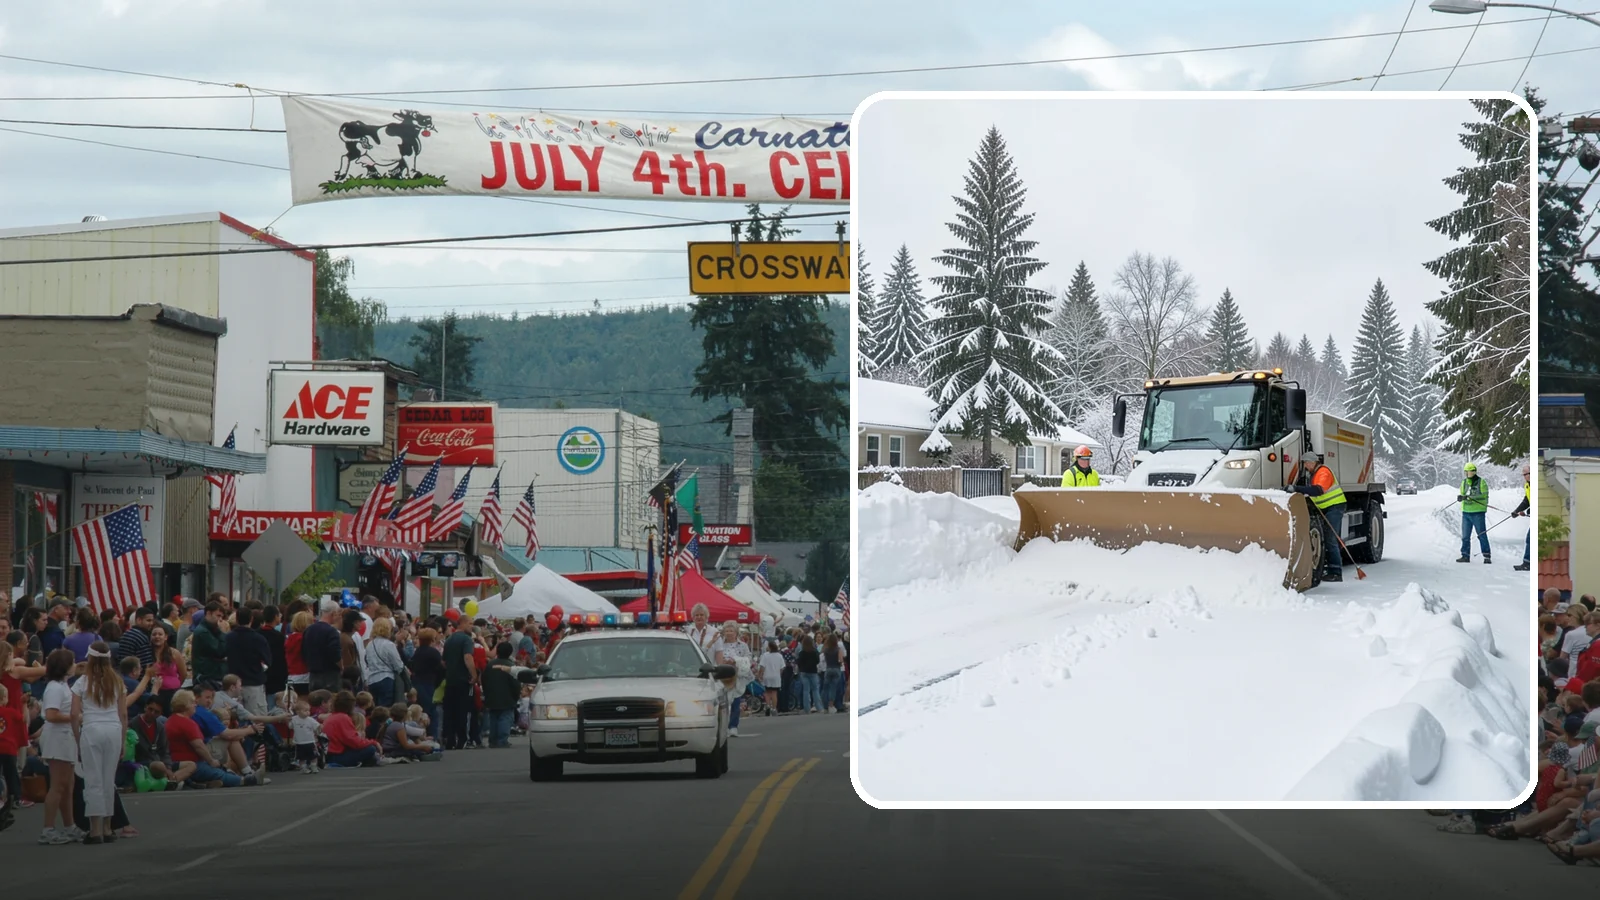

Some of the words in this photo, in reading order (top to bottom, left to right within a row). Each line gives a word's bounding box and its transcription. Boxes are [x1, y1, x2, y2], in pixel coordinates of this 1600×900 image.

[481, 141, 604, 192] JULY
[632, 150, 746, 198] 4th.
[696, 254, 850, 280] CROSSWA
[283, 380, 373, 420] ACE
[405, 409, 452, 421] CEDAR
[461, 409, 485, 421] LOG
[283, 421, 370, 436] Hardware
[416, 428, 477, 447] Coca-Cola
[353, 467, 385, 479] Simpl
[83, 486, 92, 494] St.
[95, 485, 124, 495] Vincent
[126, 486, 136, 495] de
[138, 486, 155, 495] Paul
[688, 526, 741, 535] CRNATION
[699, 535, 730, 543] GLASS
